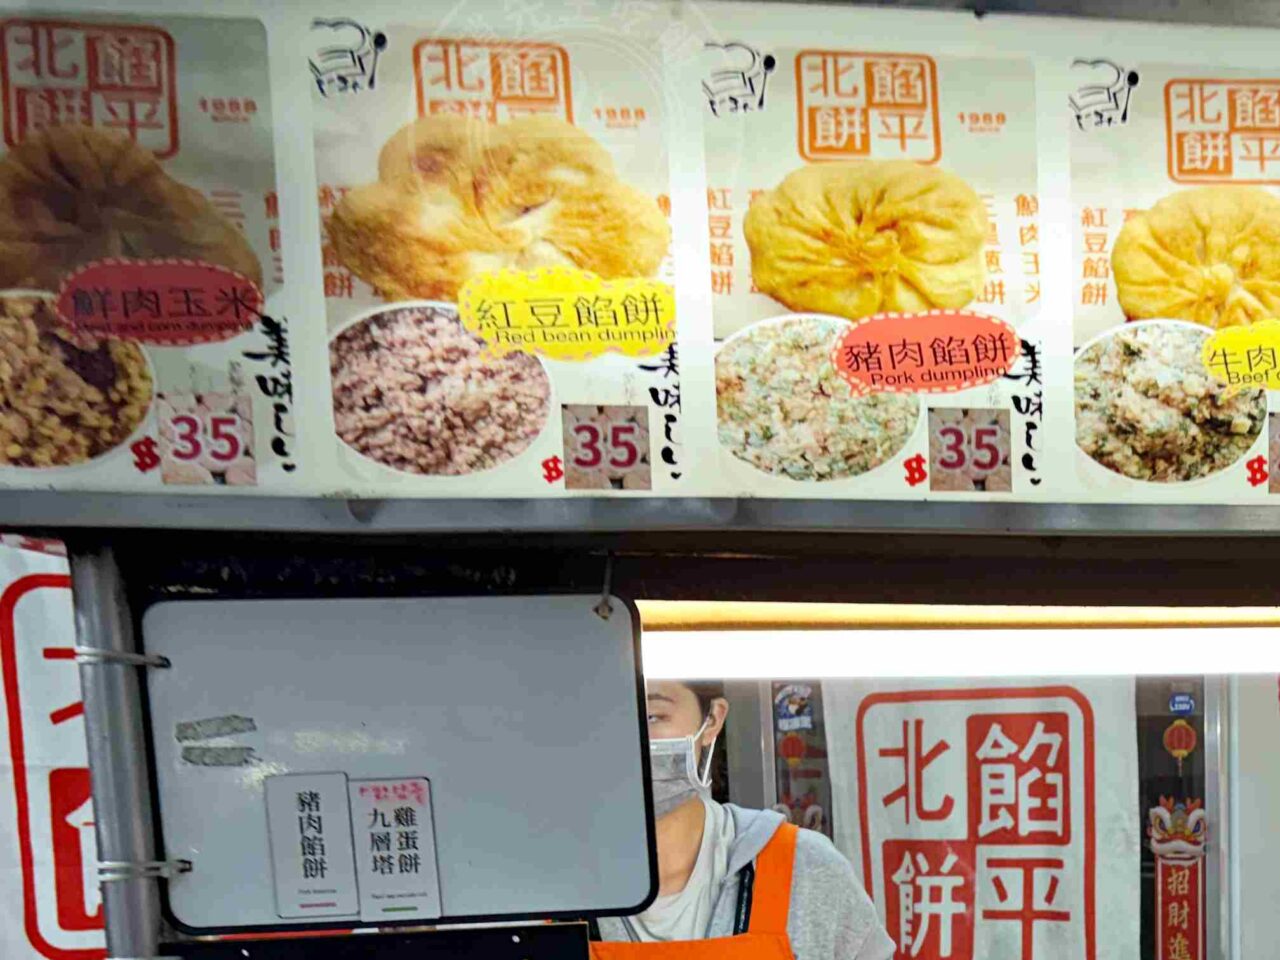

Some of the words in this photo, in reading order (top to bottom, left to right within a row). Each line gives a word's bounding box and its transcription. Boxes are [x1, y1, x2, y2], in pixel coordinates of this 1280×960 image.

[72, 287, 258, 319] 鮮肉玉米
[476, 292, 664, 330] 紅豆餡餅
[495, 329, 535, 345] Red
[542, 328, 592, 343] bean
[844, 332, 1011, 373] 豬肉餡餅
[871, 372, 914, 386] Pork
[920, 365, 1007, 383] dumpling
[1227, 370, 1272, 385] Beef
[297, 790, 328, 880] 豬肉餡餅
[368, 807, 395, 876] 九層塔
[393, 806, 421, 875] 雞蛋餅
